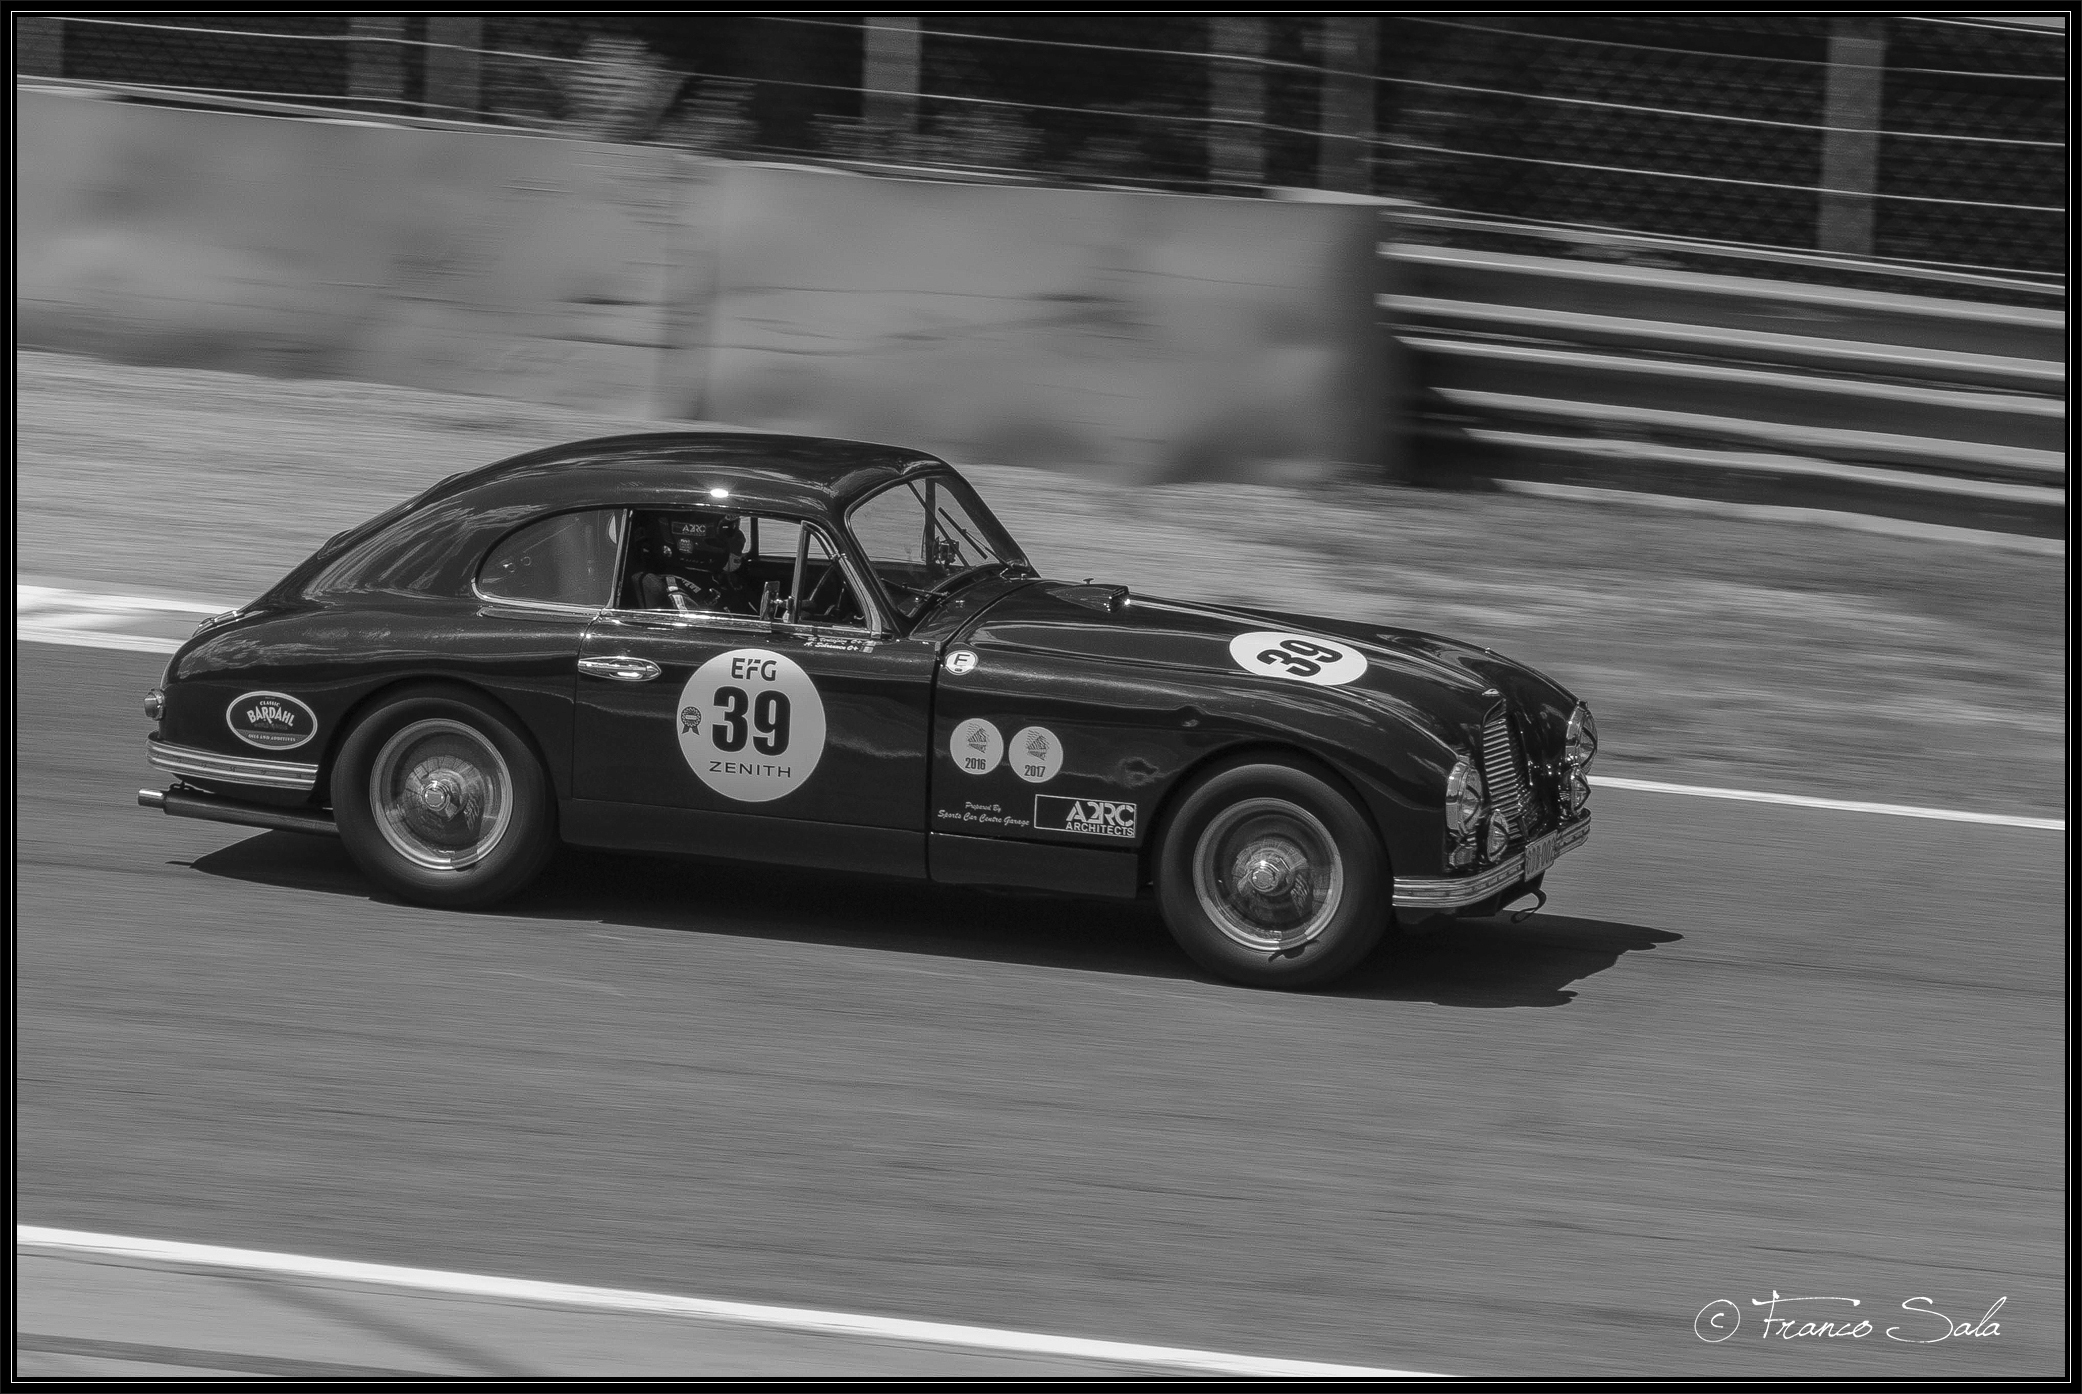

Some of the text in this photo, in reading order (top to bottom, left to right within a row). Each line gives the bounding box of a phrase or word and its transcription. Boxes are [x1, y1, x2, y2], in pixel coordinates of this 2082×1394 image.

[1256, 639, 1343, 677] 39
[731, 657, 777, 681] EFG
[246, 705, 295, 727] BARDAHL
[712, 685, 791, 756] 39
[709, 760, 791, 778] ZENITH
[965, 757, 986, 771] 2016
[1024, 764, 1046, 778] 2017
[965, 801, 1002, 813] Prepared By
[937, 809, 962, 821] Sports
[963, 812, 978, 822] Car
[1003, 815, 1030, 827] Garage
[1066, 821, 1134, 837] ARCHITECTS
